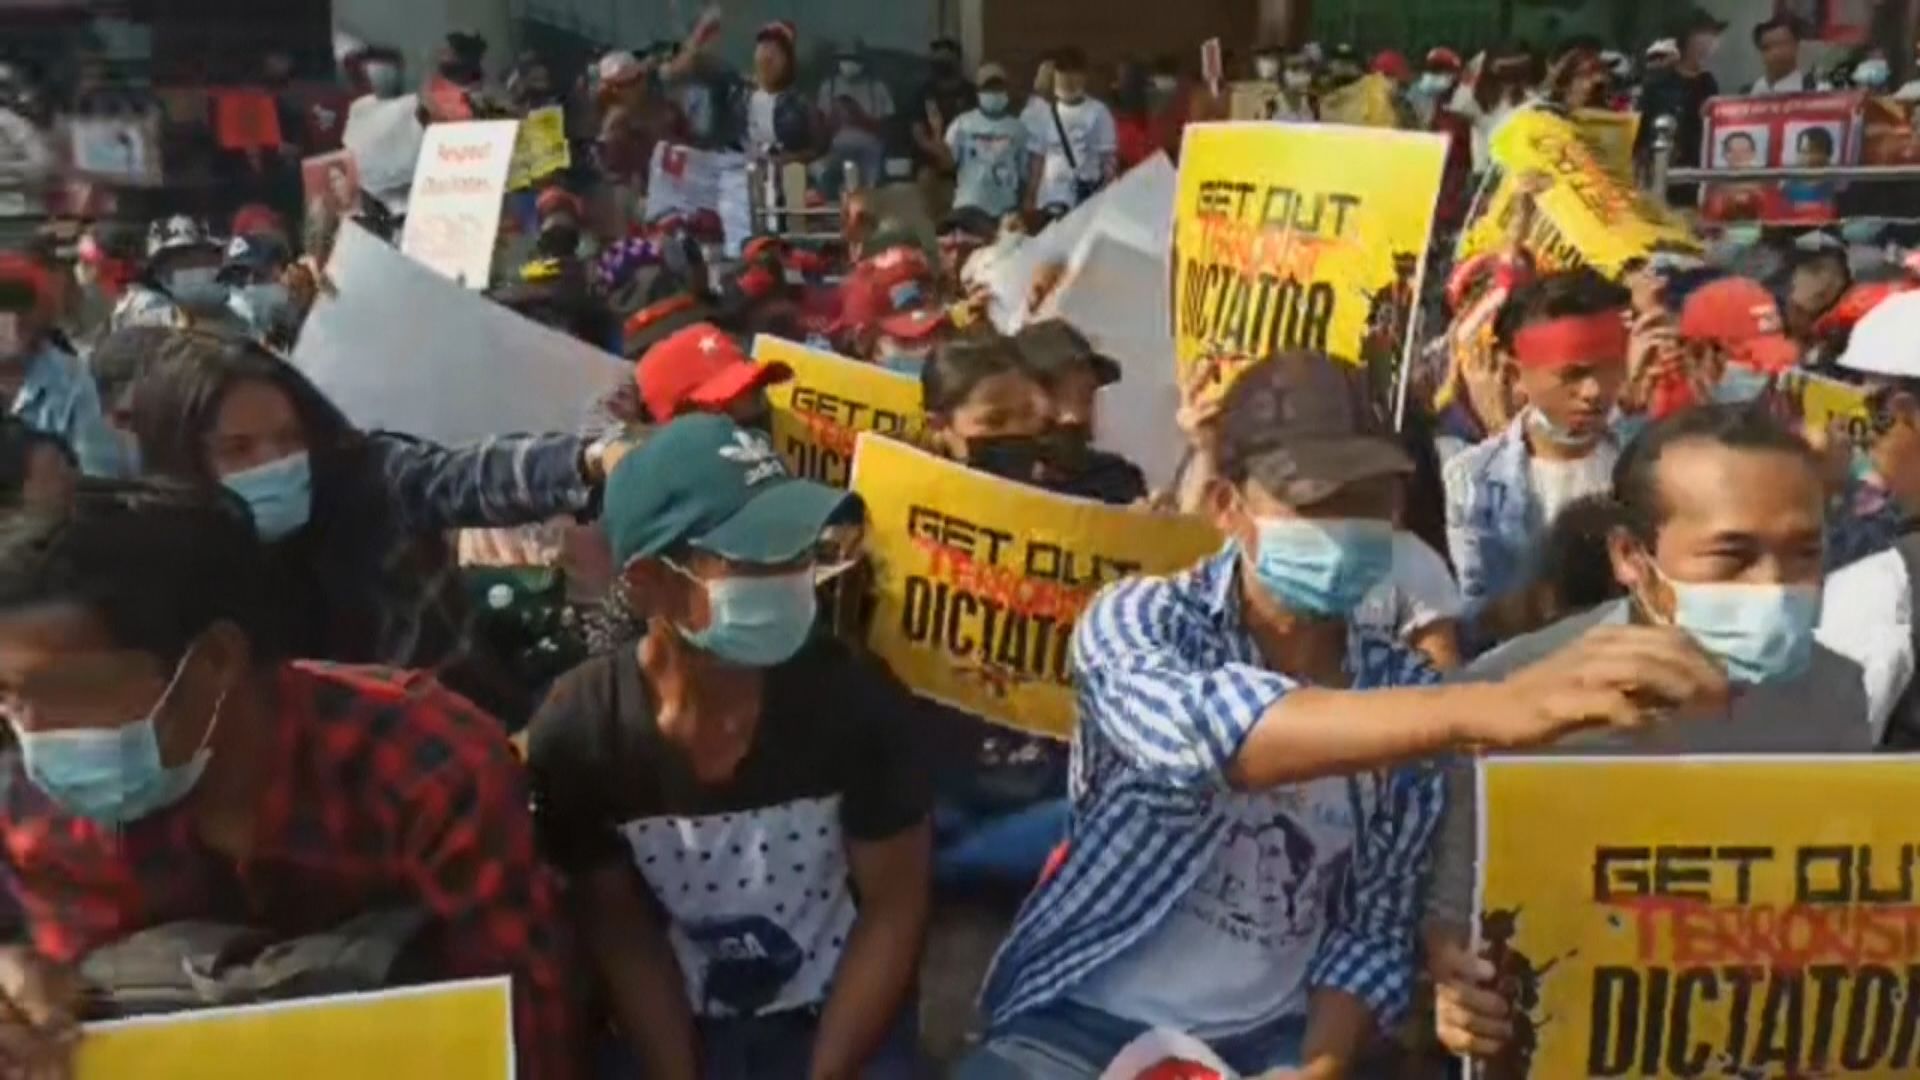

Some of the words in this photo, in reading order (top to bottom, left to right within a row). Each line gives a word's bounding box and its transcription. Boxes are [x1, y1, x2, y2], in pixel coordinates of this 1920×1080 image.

[1196, 180, 1257, 220] GET
[1259, 185, 1363, 237] OUT
[791, 386, 869, 429] GET
[907, 505, 1013, 565] GET
[1024, 539, 1142, 587] OUT
[1594, 845, 1773, 903] GET
[1795, 845, 1920, 903] OU
